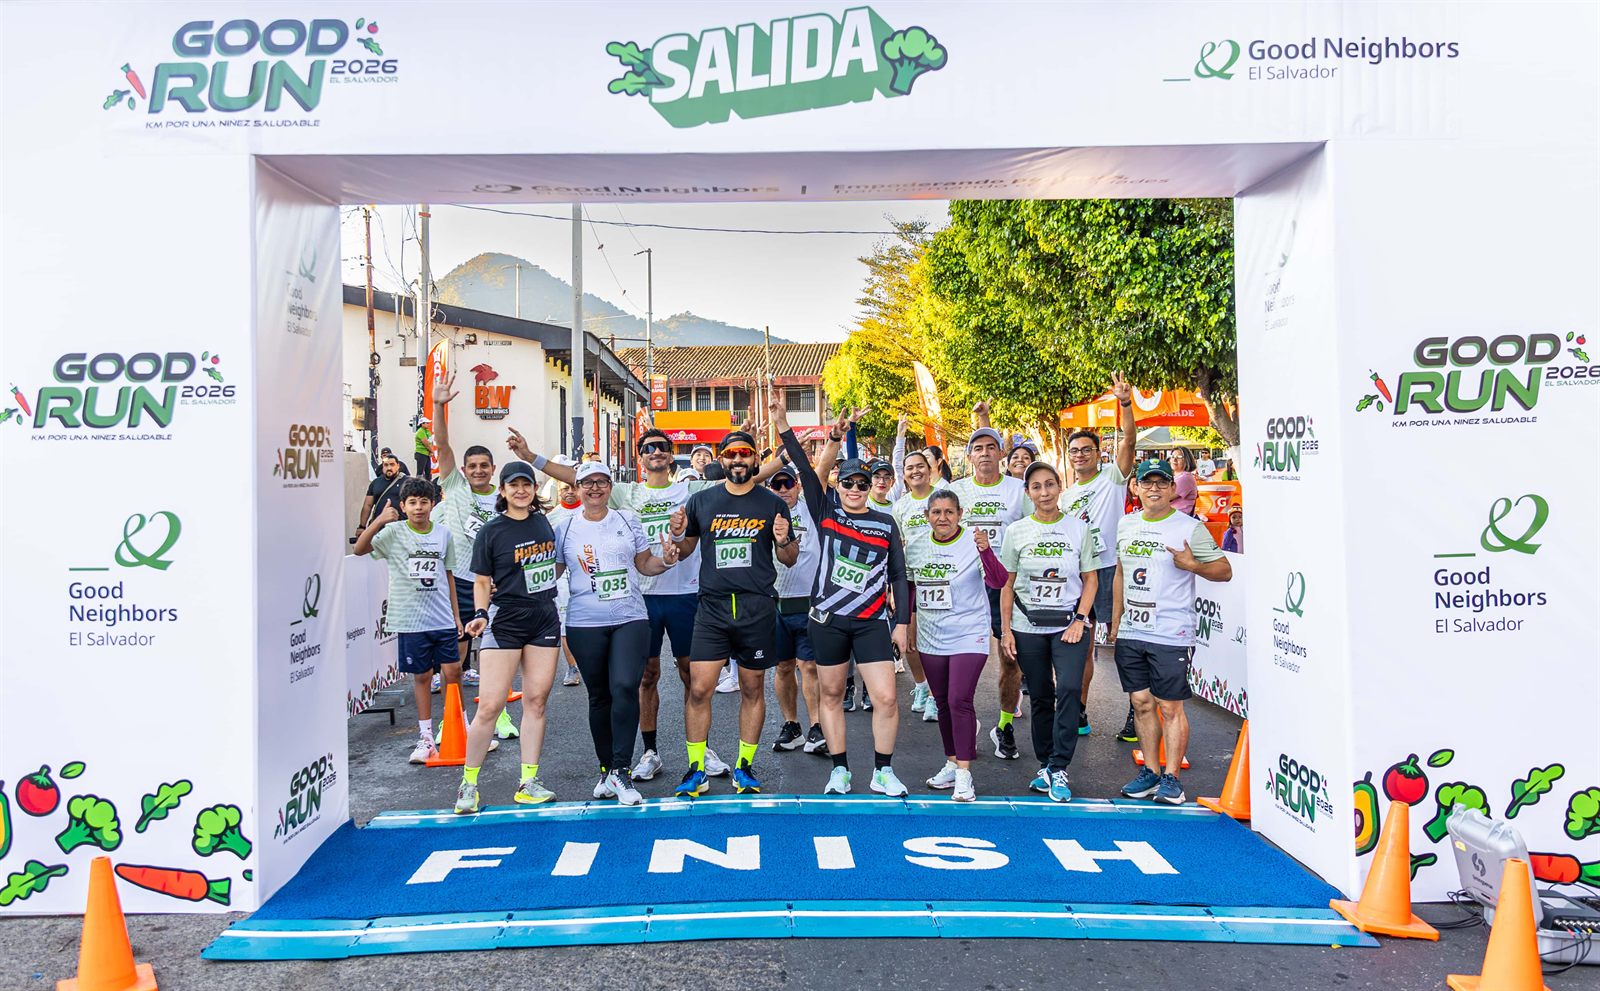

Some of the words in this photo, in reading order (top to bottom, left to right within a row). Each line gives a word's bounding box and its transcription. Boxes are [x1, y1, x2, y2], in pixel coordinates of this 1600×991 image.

[173, 19, 348, 57] GOOD
[649, 6, 880, 103] SALIDA
[1248, 38, 1316, 60] Good
[1324, 36, 1460, 65] Neighbors
[331, 59, 398, 74] 2026
[1248, 66, 1261, 80] El
[1266, 65, 1338, 80] Salvador
[148, 60, 326, 114] RUN
[1414, 333, 1561, 368] GOOD
[53, 352, 196, 383] GOOD
[1545, 366, 1600, 379] 2026
[182, 386, 236, 398] 2026
[475, 386, 512, 408] BW
[1393, 367, 1542, 416] RUN
[33, 386, 178, 428] RUN
[289, 424, 324, 448] GOOD
[1267, 416, 1305, 440] GOOD
[284, 448, 320, 480] RUN
[1263, 441, 1300, 472] RUN
[1217, 498, 1227, 507] G
[710, 518, 766, 532] HUEVOS
[715, 529, 724, 538] Y
[724, 527, 759, 537] POLLO
[514, 541, 554, 564] HUEVO
[720, 547, 747, 560] 008
[1033, 548, 1063, 556] RUN
[1126, 546, 1153, 556] RUN
[414, 561, 436, 571] 142
[532, 568, 554, 584] 009
[837, 566, 864, 584] 050
[918, 569, 947, 578] RUN
[1434, 566, 1490, 586] Good
[69, 581, 123, 599] Good
[602, 577, 626, 592] 035
[1035, 586, 1062, 598] 121
[921, 590, 945, 602] 112
[1435, 589, 1547, 612] Neighbors
[69, 604, 178, 626] Neighbors
[1128, 608, 1150, 623] 120
[1195, 597, 1216, 618] OOD
[1196, 616, 1211, 641] UN
[1273, 618, 1289, 635] Good
[1436, 619, 1448, 633] El
[1454, 617, 1524, 632] Salvador
[69, 632, 82, 646] El
[87, 632, 155, 646] Salvador
[290, 629, 306, 647] Good
[1273, 635, 1307, 658] Neighbors
[290, 644, 320, 664] Neighbors
[290, 756, 326, 797] GOOD
[1279, 754, 1320, 793] GOOD
[1276, 772, 1315, 823] RUN
[284, 780, 322, 836] RUN
[406, 834, 1180, 885] FINISH
